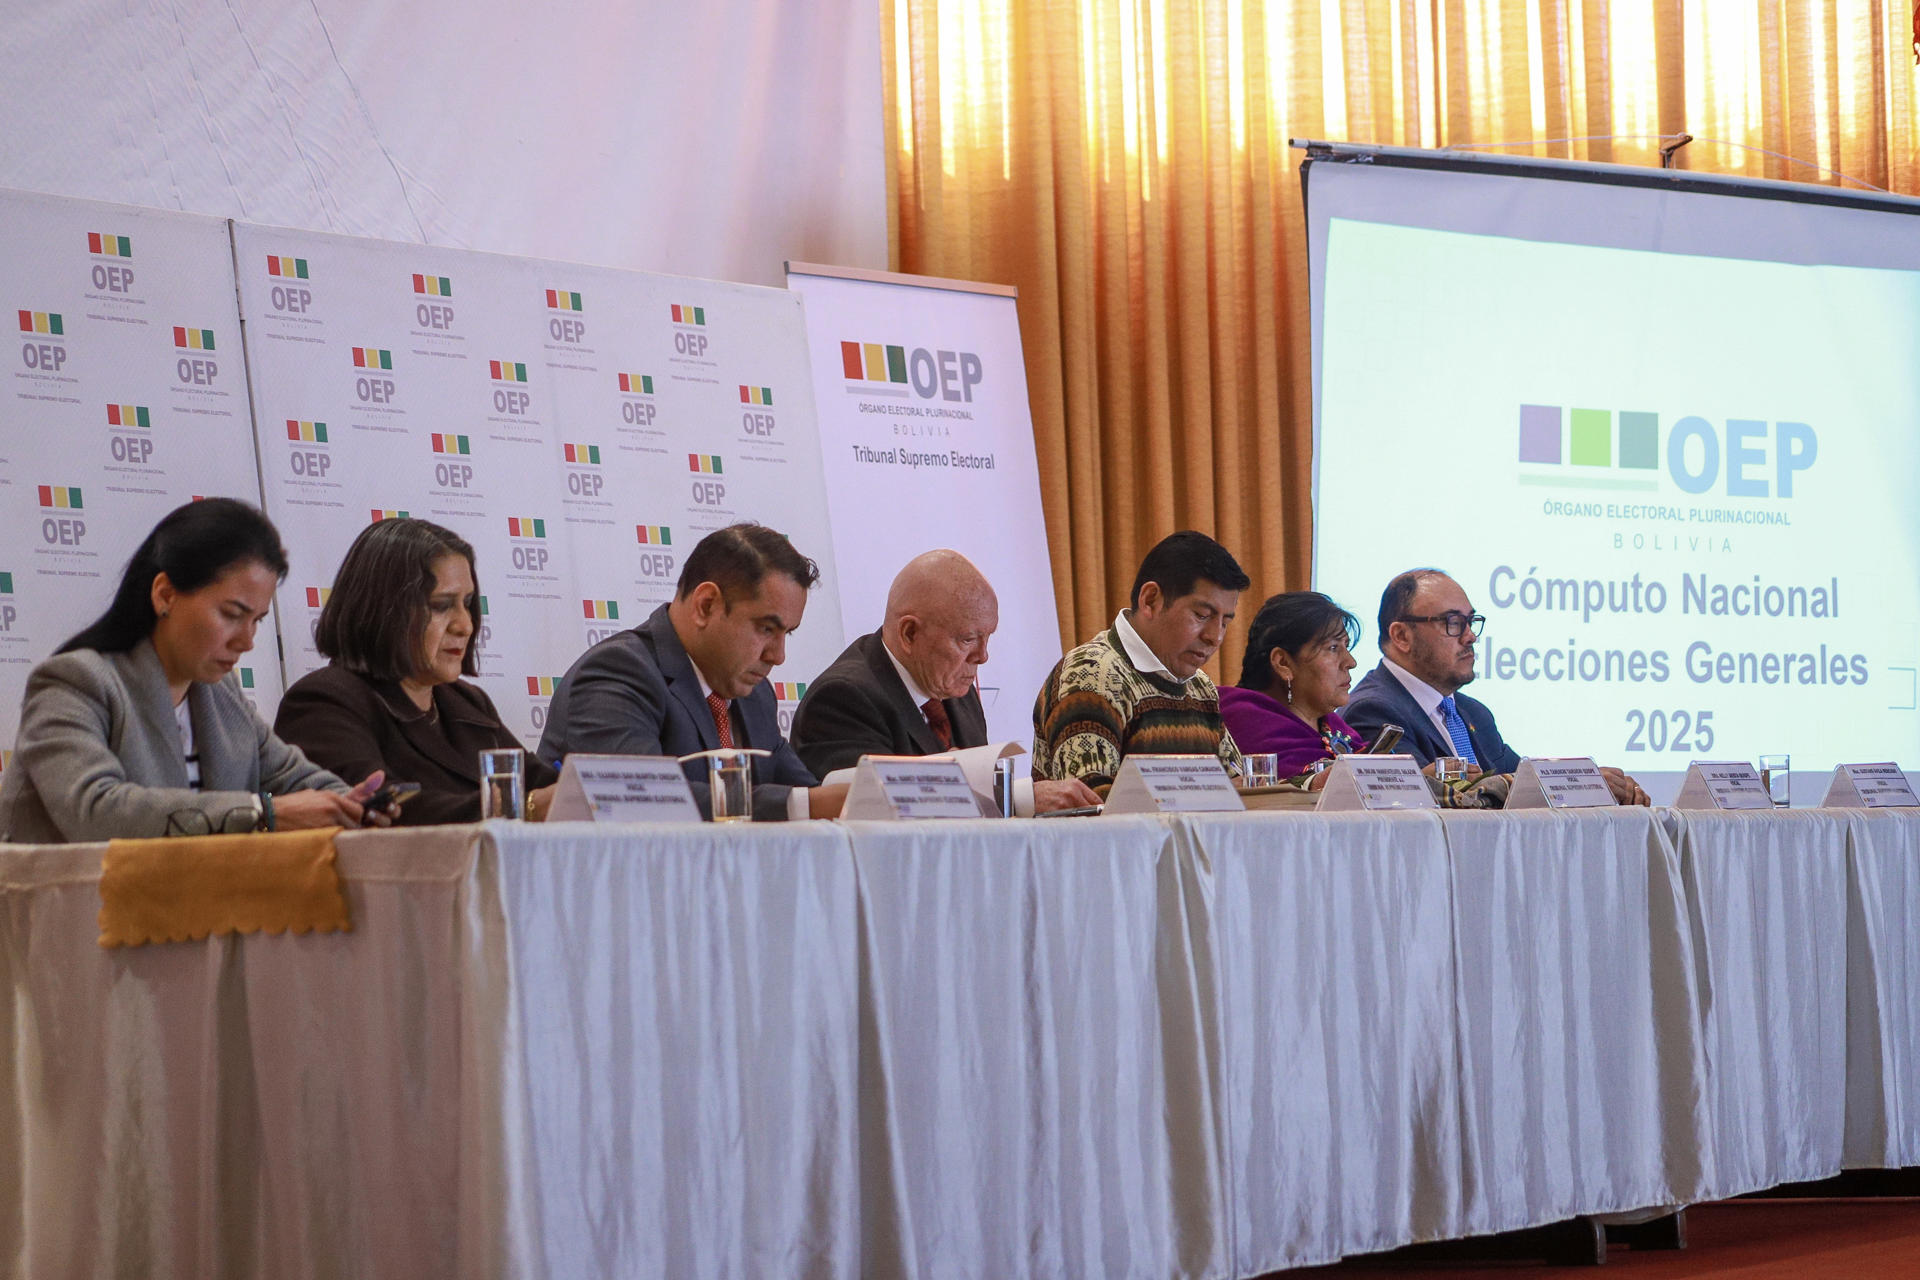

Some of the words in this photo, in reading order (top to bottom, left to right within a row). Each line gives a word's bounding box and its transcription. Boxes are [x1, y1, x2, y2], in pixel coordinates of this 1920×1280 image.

[92, 265, 134, 293] OEP
[271, 286, 311, 313] OEP
[416, 304, 454, 330] OEP
[550, 318, 584, 343] OEP
[23, 343, 66, 371] OEP
[674, 331, 708, 357] OEP
[177, 358, 218, 385] OEP
[910, 347, 983, 402] OEP
[356, 377, 395, 404] OEP
[493, 390, 530, 415] OEP
[622, 402, 656, 425] OEP
[743, 413, 775, 436] OEP
[859, 402, 886, 414] ÓRGANO
[888, 405, 924, 417] ELECTORAL
[925, 408, 973, 421] PLURINACIONAL
[893, 424, 951, 437] BOLIVIA
[111, 436, 153, 463] OEP
[853, 445, 897, 464] Tribunal
[900, 448, 948, 469] Supremo
[951, 451, 995, 469] Electoral
[1667, 416, 1818, 498] OEP
[290, 451, 331, 477] OEP
[435, 463, 472, 488] OEP
[568, 473, 603, 497] OEP
[692, 482, 725, 505] OEP
[1543, 498, 1602, 517] ÓRGANO
[1607, 504, 1685, 521] ELECTORAL
[1689, 508, 1791, 526] PLURINACIONAL
[42, 518, 85, 545] OEP
[1614, 533, 1732, 552] BOLIVIA
[512, 547, 548, 571] OEP
[640, 554, 674, 577] OEP
[1489, 565, 1667, 623] Cómputo
[1682, 573, 1839, 618] Nacional
[1475, 636, 1670, 682] lecciones
[1685, 641, 1869, 685] Generales
[1625, 709, 1714, 752] 2025
